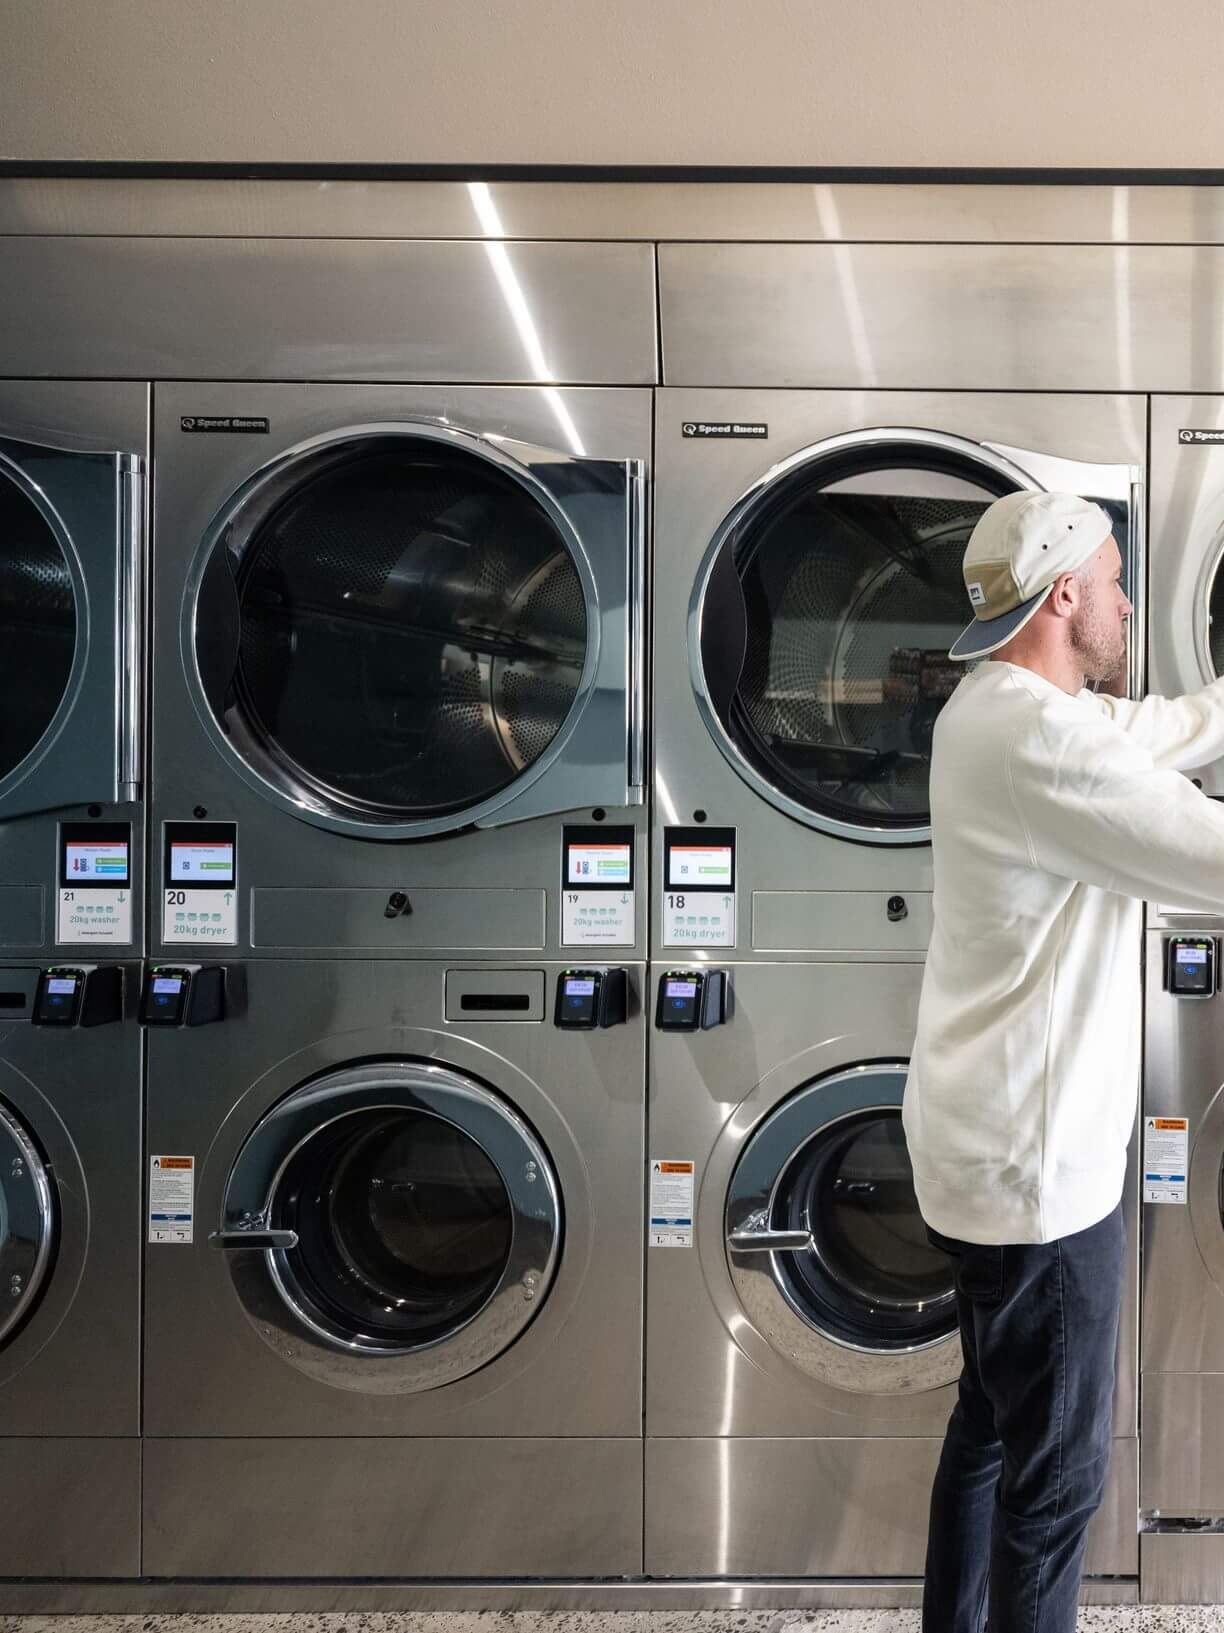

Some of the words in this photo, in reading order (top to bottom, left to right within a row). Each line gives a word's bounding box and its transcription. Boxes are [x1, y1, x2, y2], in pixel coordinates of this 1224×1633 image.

[698, 425, 731, 434] Speed
[733, 425, 766, 433] Queen
[63, 892, 75, 901] 21
[167, 891, 186, 905] 20
[568, 894, 578, 904] 19
[668, 895, 686, 909] 18
[69, 916, 89, 925] 20kg
[91, 916, 120, 924] washer
[573, 918, 593, 927] 20kg
[594, 918, 623, 926] washer
[173, 924, 198, 936] 20kg
[200, 924, 227, 936] dryer
[673, 928, 698, 939] 20kg
[699, 928, 726, 939] dryer
